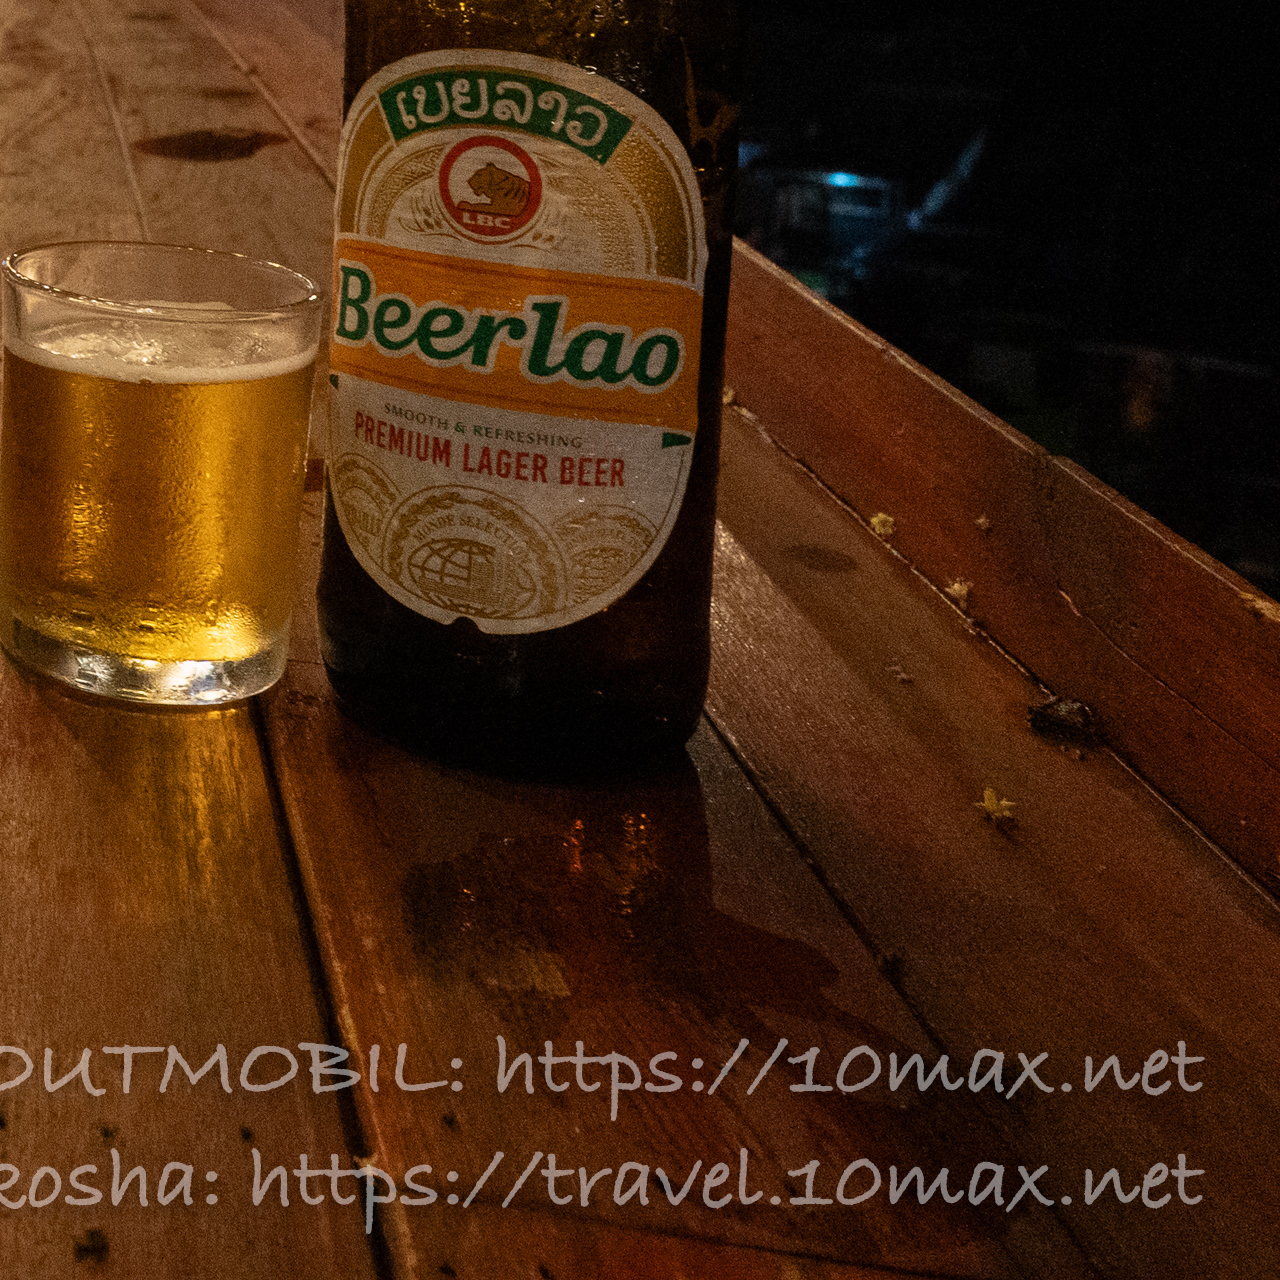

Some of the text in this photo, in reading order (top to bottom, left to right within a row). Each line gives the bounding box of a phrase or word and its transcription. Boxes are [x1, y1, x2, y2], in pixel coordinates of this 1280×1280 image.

[396, 78, 608, 147] ເບຍລາວ
[462, 212, 512, 229] LBC
[334, 265, 682, 388] Beerlao
[355, 410, 625, 487] PREMIUM LAGER BEER
[384, 403, 583, 449] SMOOTH & REFRESHING
